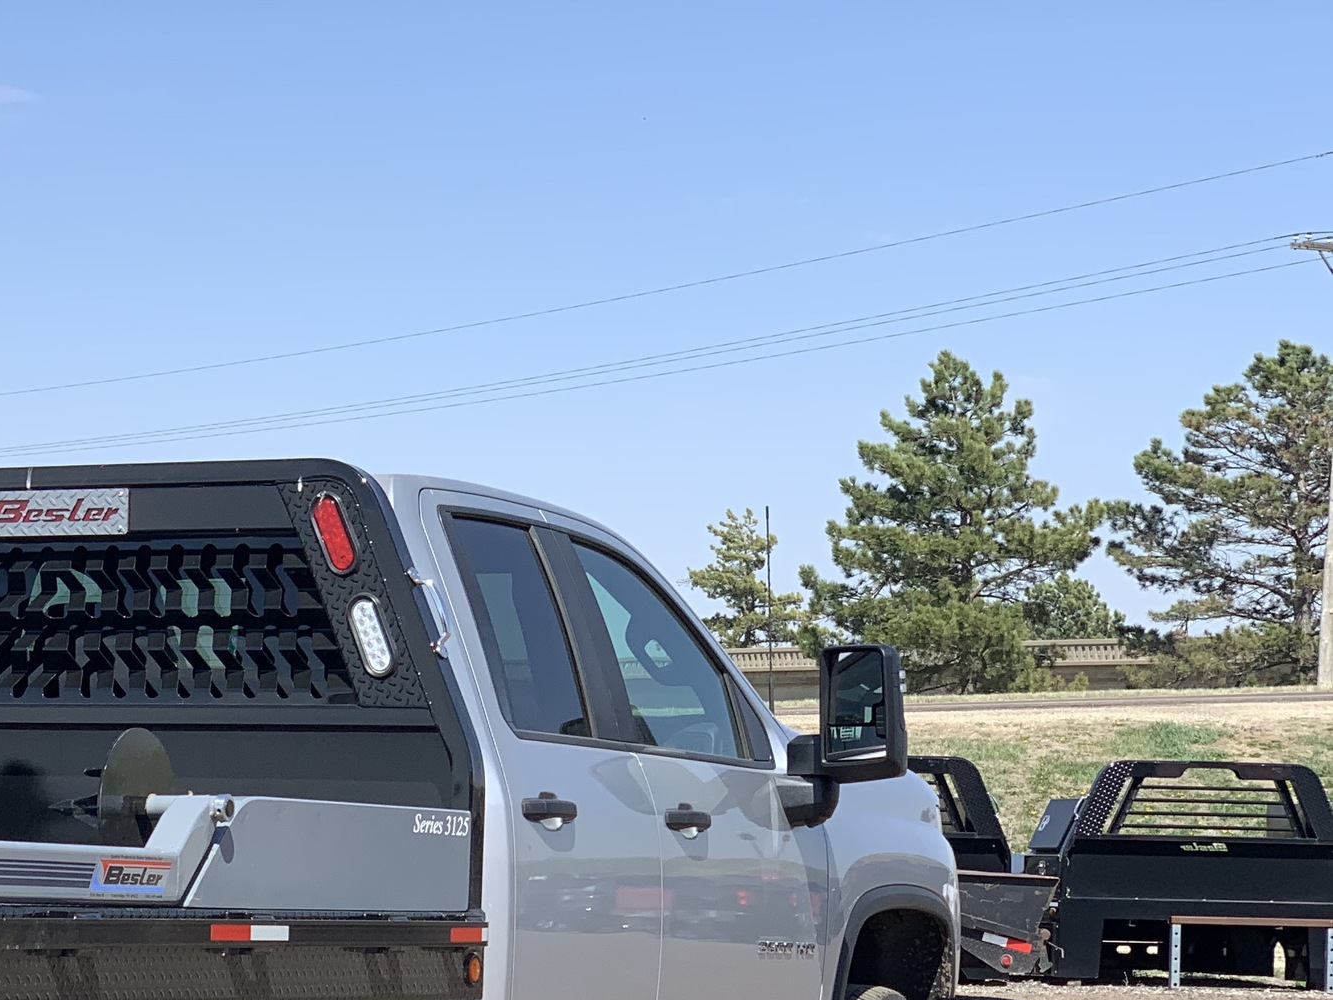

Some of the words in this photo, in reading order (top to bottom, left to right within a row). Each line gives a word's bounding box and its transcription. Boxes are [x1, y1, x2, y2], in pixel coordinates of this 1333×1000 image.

[412, 813, 444, 835] Series
[444, 815, 470, 837] 3125
[103, 865, 164, 886] Besler
